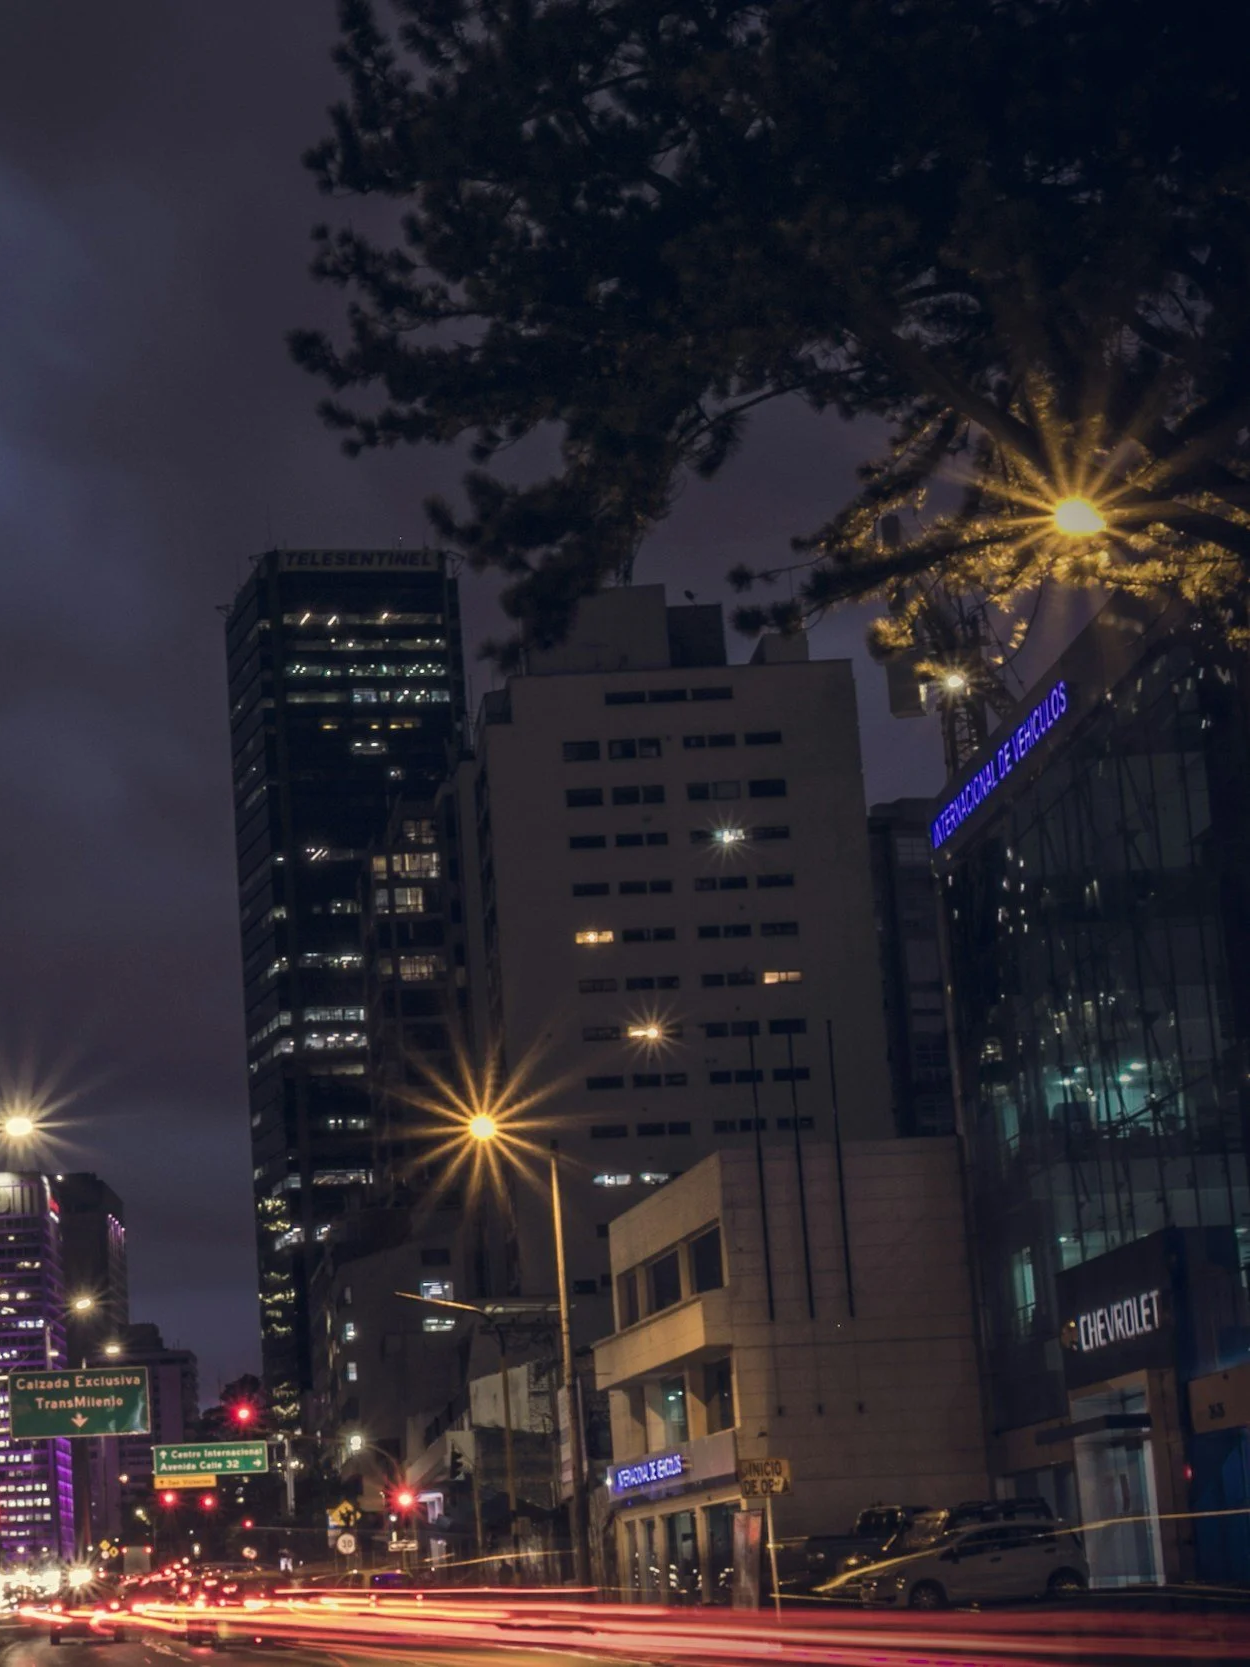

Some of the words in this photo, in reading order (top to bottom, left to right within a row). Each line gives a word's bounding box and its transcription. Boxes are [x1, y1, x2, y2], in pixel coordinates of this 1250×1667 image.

[286, 551, 432, 567] TELESENTINEL
[930, 760, 998, 849] INTERNACIONAL
[997, 740, 1013, 779] DE
[1011, 680, 1068, 763] VEHICULOS
[1079, 1289, 1160, 1352] CHEVROLET
[15, 1377, 70, 1390] Calzada
[74, 1374, 141, 1388] Exclusiva
[34, 1395, 124, 1410] TransMilenio
[171, 1450, 202, 1459] Centro
[204, 1447, 263, 1458] Internacional
[160, 1462, 197, 1472] Avenida
[199, 1460, 223, 1470] Calle
[226, 1459, 240, 1469] 32
[743, 1479, 759, 1495] DE
